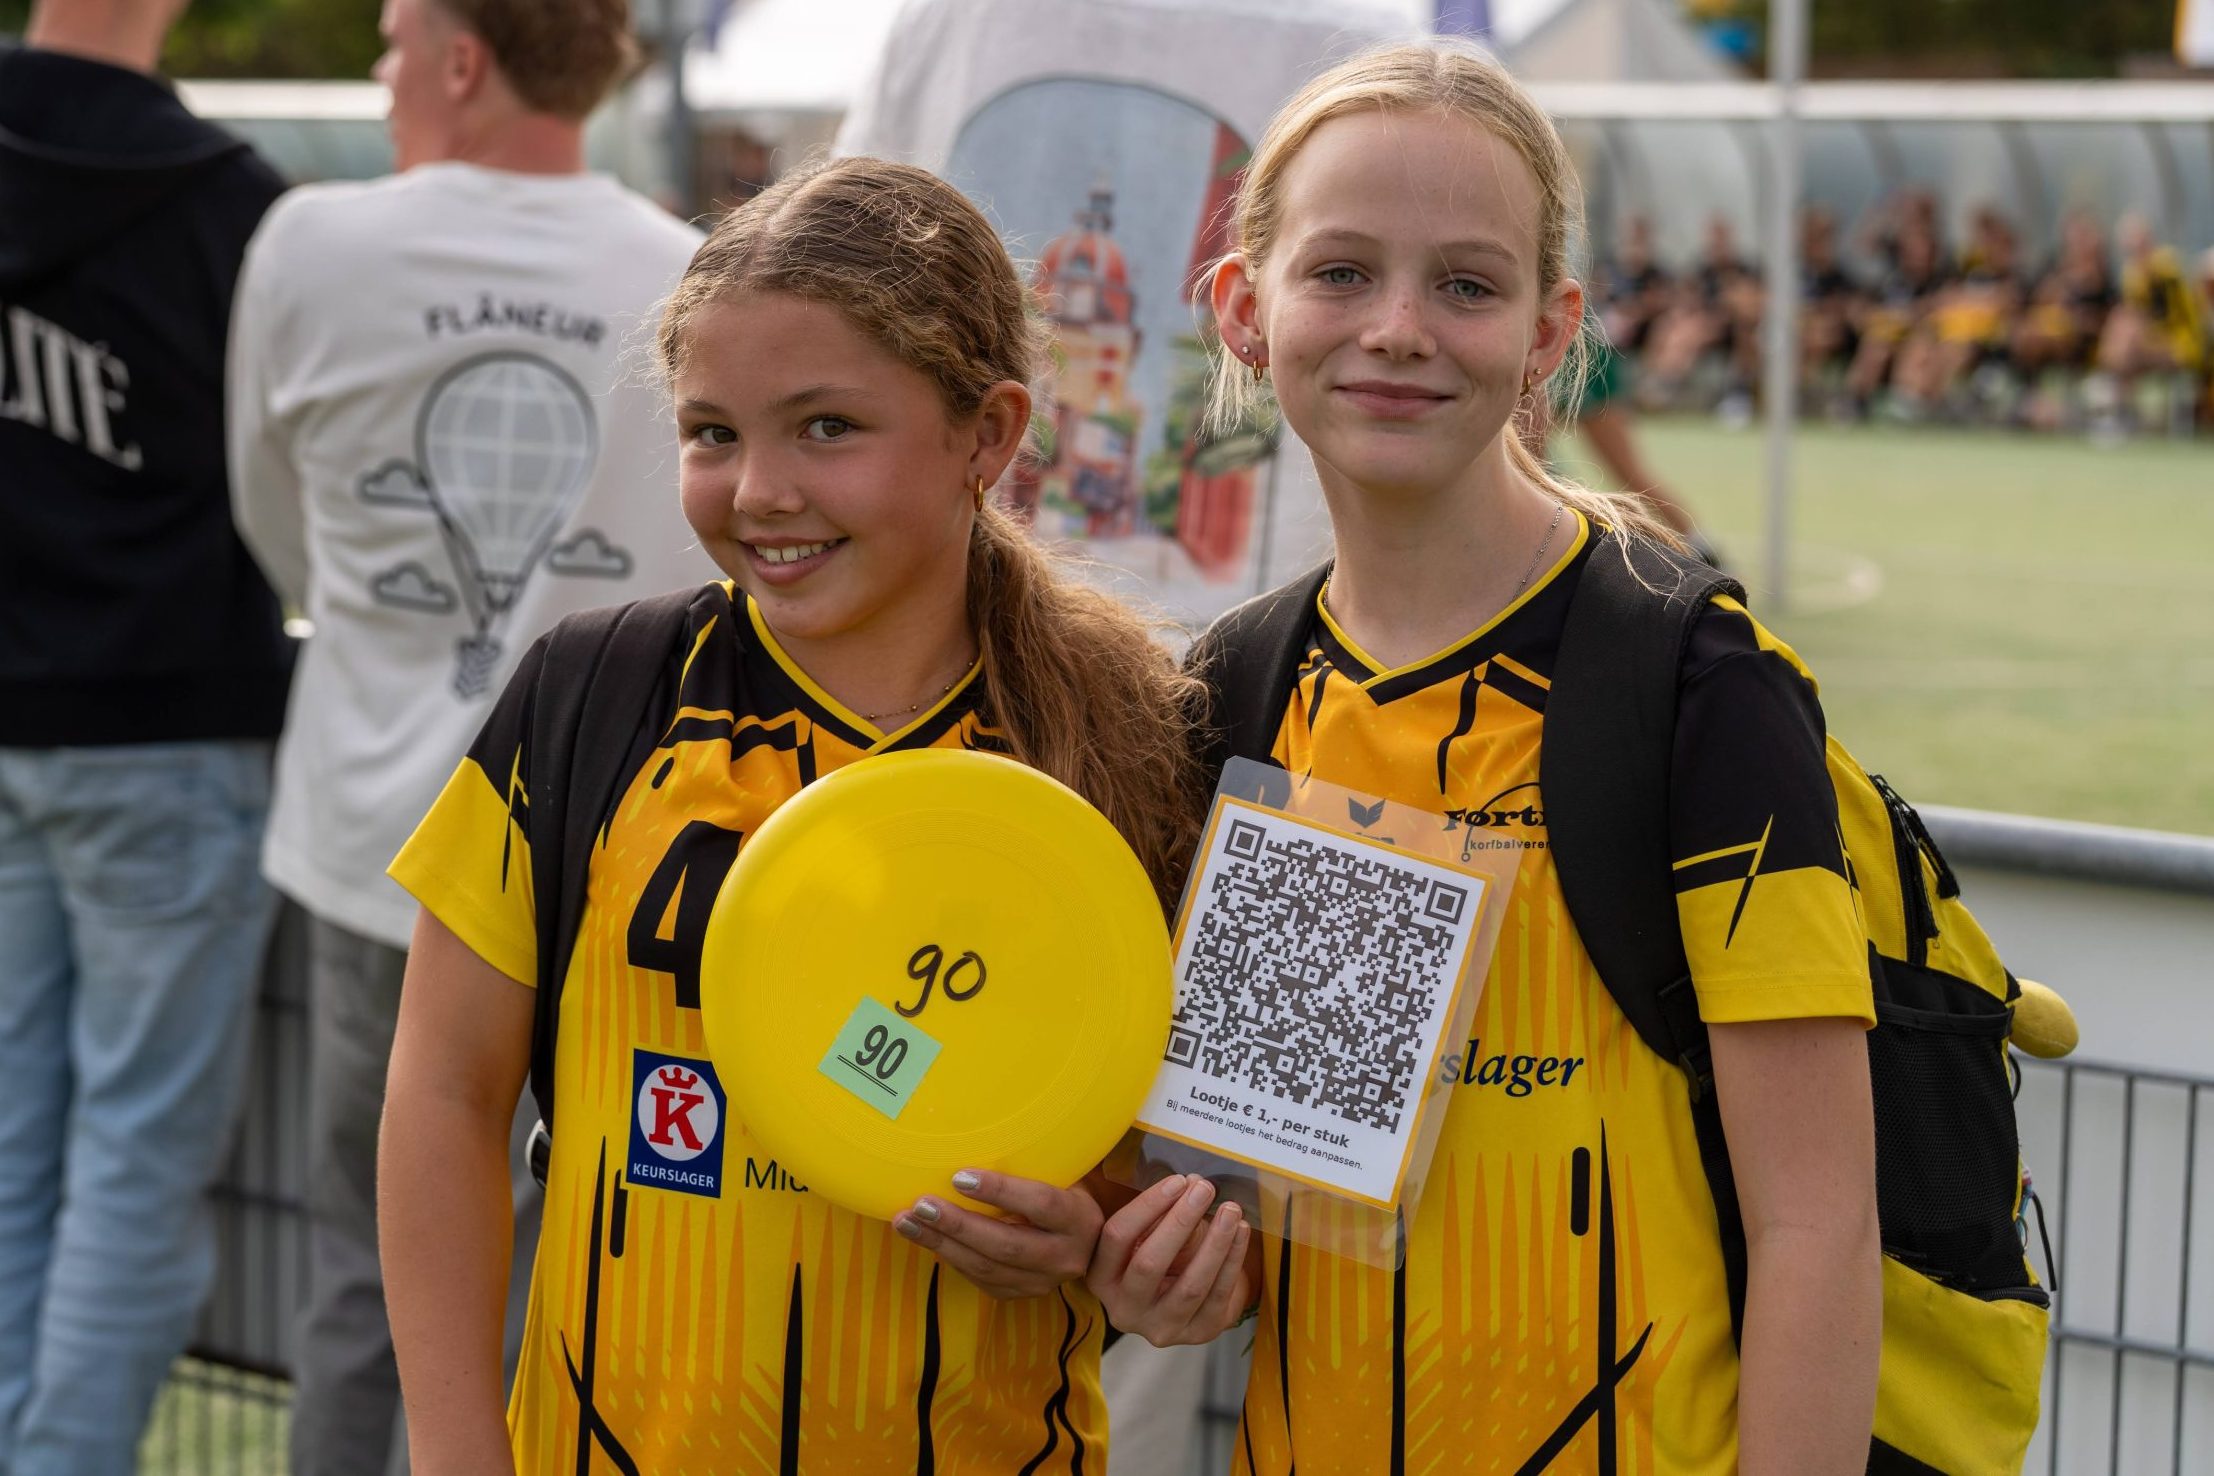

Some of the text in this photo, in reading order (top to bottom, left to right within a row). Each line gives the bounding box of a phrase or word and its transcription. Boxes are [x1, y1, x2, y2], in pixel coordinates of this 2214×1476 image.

[855, 1024, 908, 1080] 90
[648, 1086, 705, 1151] K
[1166, 1099, 1363, 1170] Bij meerdere lootjes het bedrag aanpassen.
[1190, 1086, 1239, 1113] Lootje
[1243, 1104, 1254, 1117] €
[1281, 1117, 1311, 1136] per
[1313, 1127, 1350, 1148] stuk
[633, 1162, 714, 1188] KEURSLAGER
